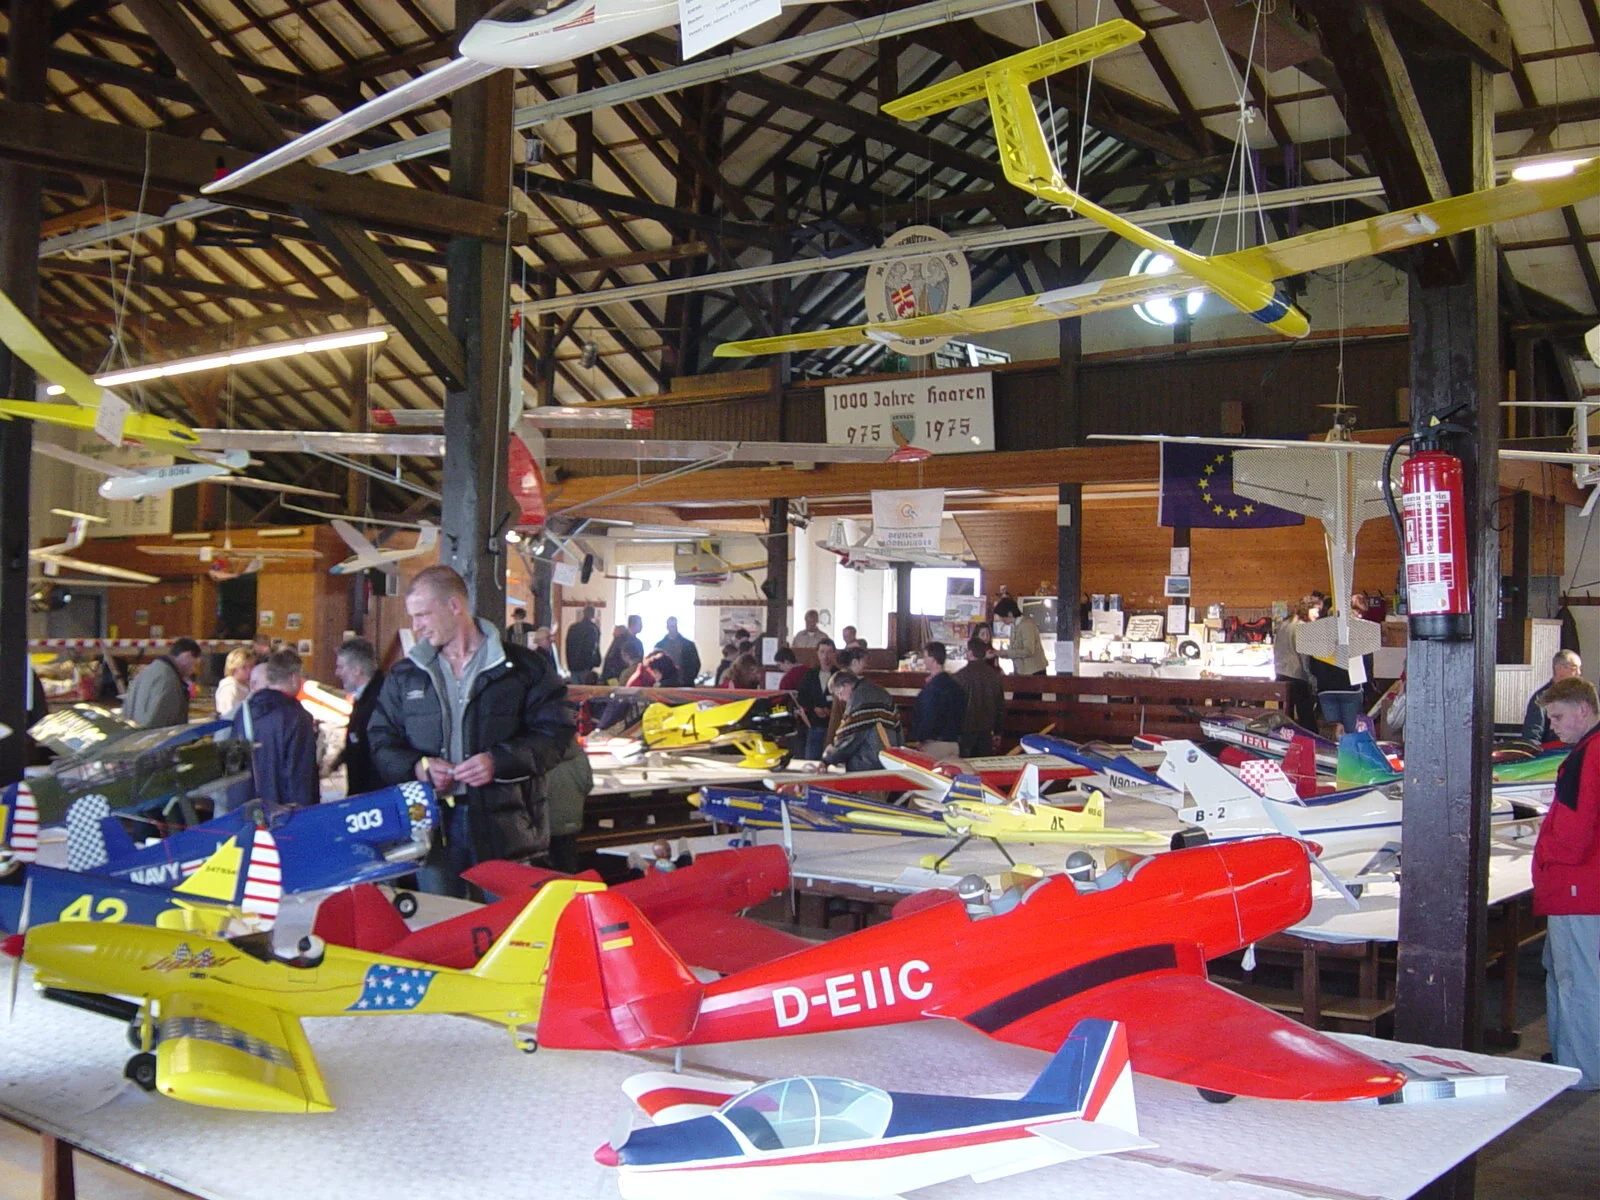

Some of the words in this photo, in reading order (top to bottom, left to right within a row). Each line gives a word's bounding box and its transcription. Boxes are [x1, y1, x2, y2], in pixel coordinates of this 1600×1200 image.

[833, 392, 868, 411] 1000
[874, 389, 916, 407] Jahre
[847, 424, 881, 444] 975
[926, 418, 971, 442] 1975
[681, 713, 700, 741] 4
[1239, 733, 1271, 750] TEFAL
[345, 808, 383, 833] 303
[130, 862, 180, 886] NAVY
[59, 894, 128, 923] 42
[772, 959, 934, 1028] D-EIIC
